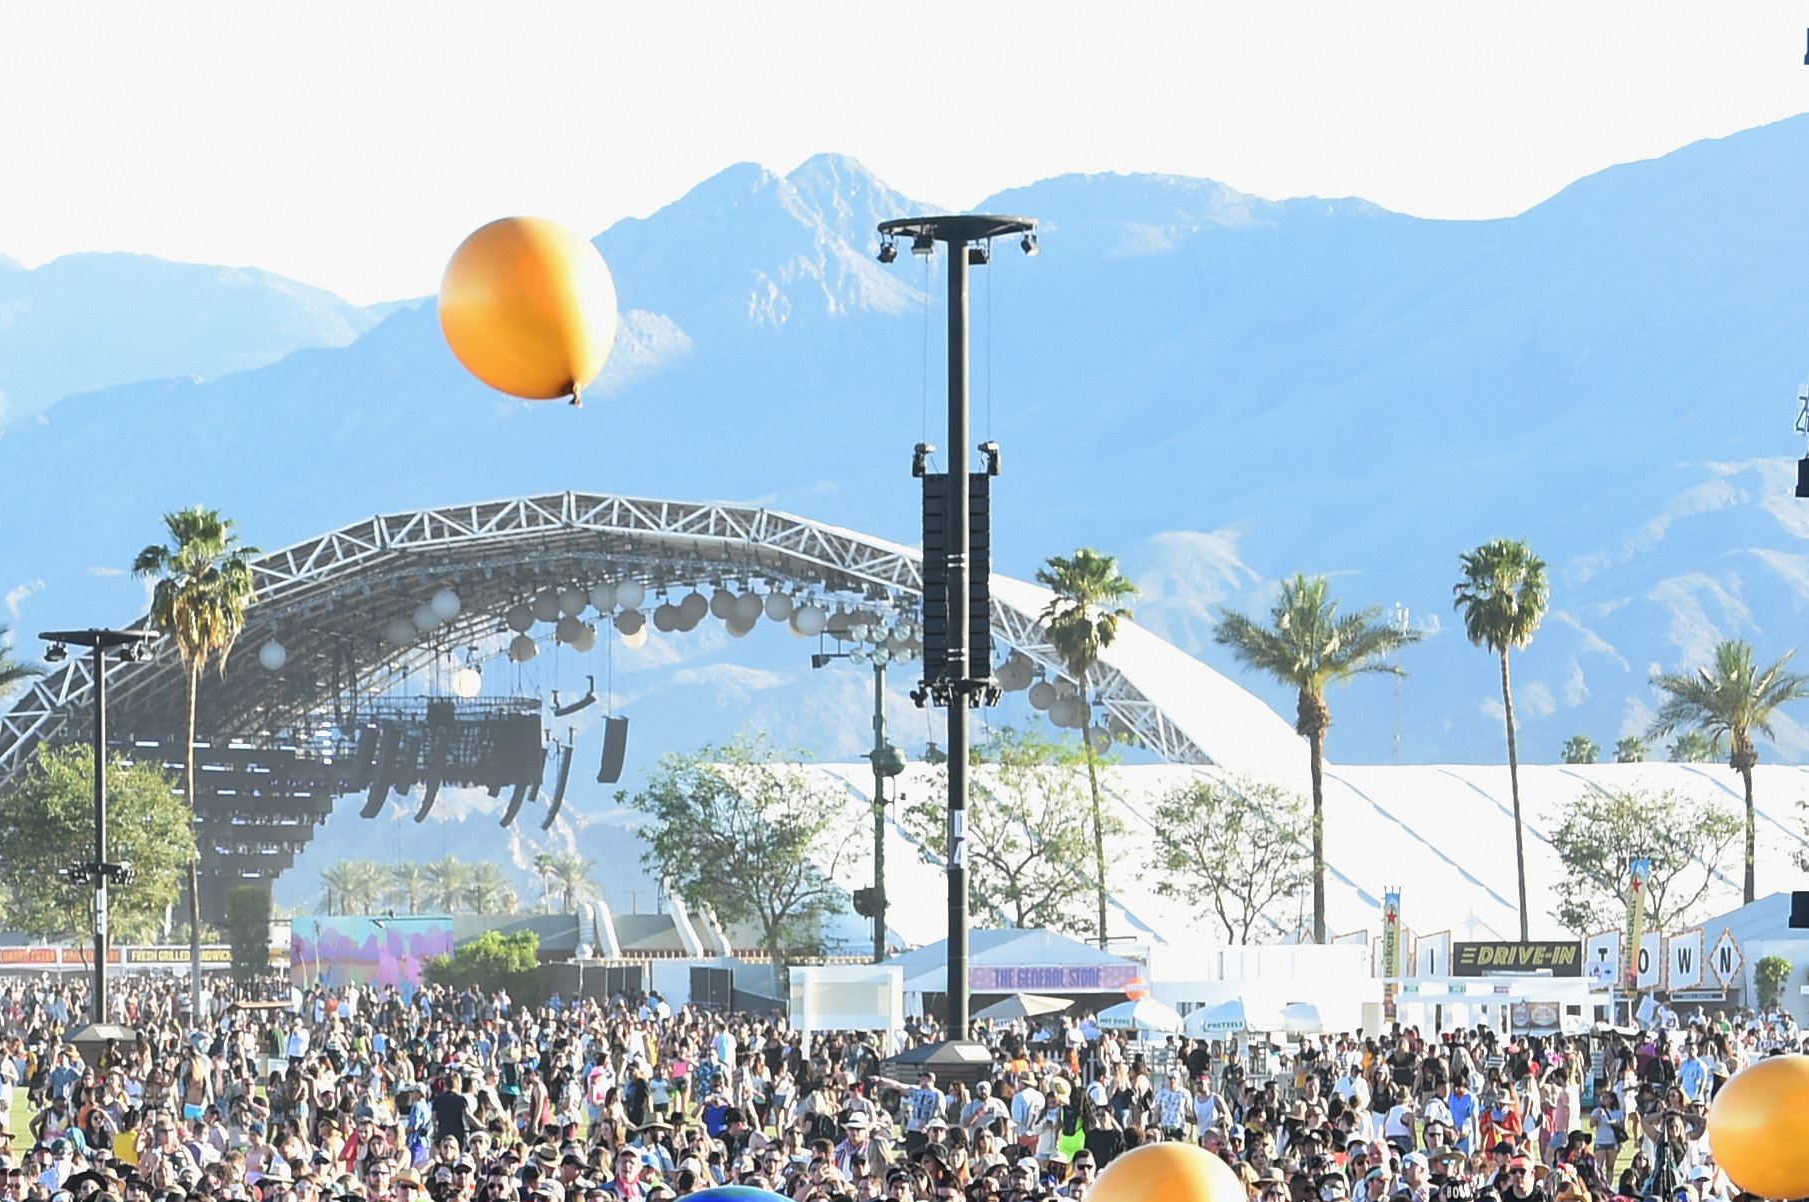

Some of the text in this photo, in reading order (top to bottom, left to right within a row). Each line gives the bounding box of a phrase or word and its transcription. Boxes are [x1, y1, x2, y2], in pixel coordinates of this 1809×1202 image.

[131, 950, 157, 962] FRESH
[159, 950, 190, 962] GRILLED
[1477, 945, 1577, 965] DRIVE-IN
[994, 967, 1102, 988] THE GENERAL STORE
